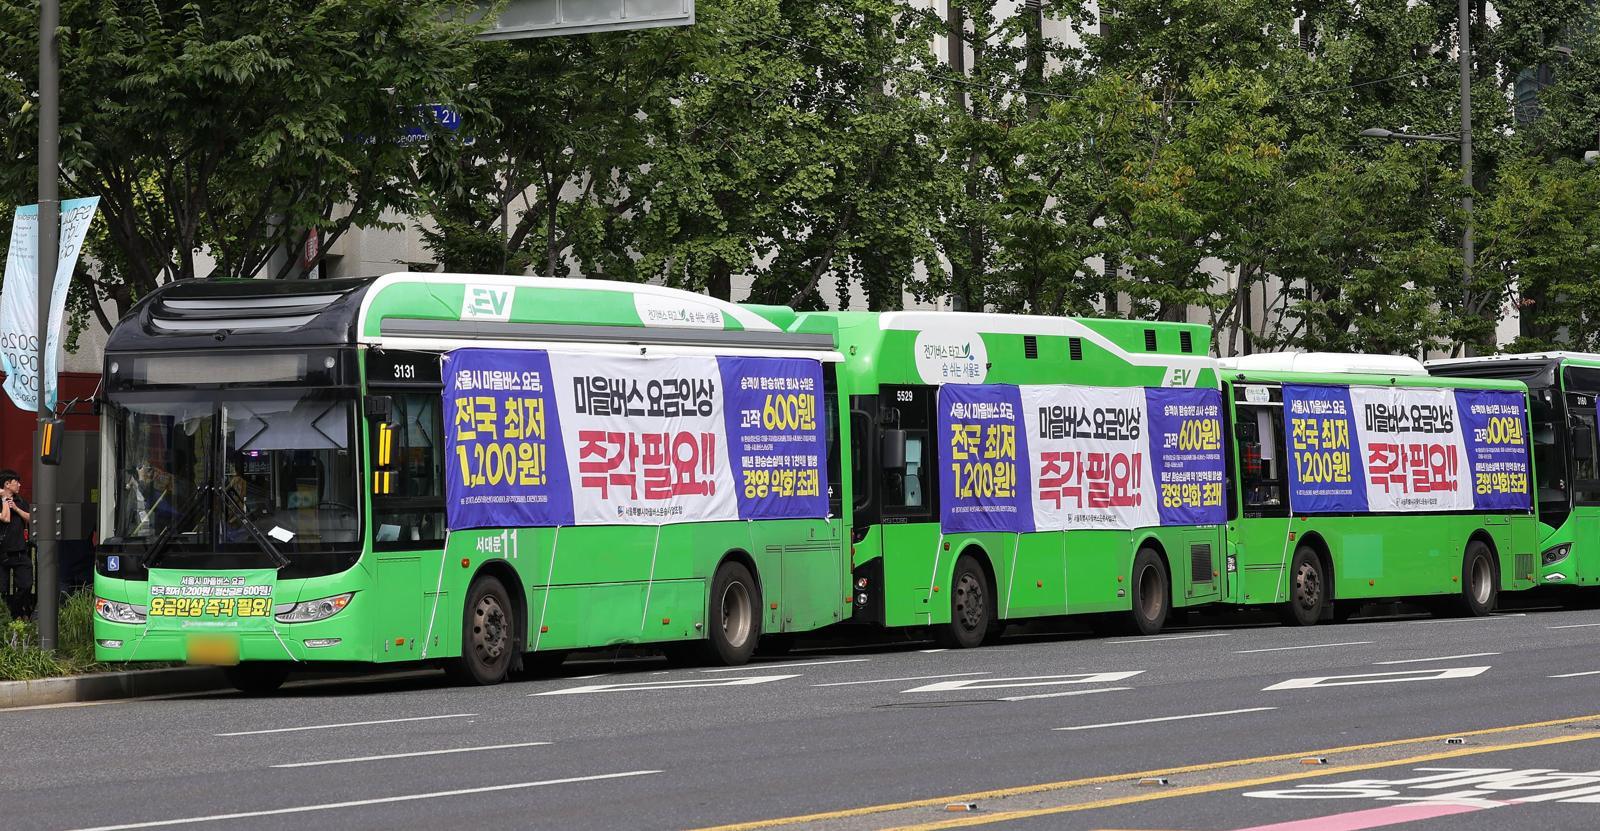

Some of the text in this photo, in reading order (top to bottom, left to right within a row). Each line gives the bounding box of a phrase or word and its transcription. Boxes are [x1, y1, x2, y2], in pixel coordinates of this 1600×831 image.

[472, 288, 508, 316] EV
[924, 344, 961, 359] 전기버스 타고
[394, 364, 415, 378] 3131
[455, 370, 543, 393] 서울시 마을버스 요금,
[741, 377, 759, 390] 승객이
[760, 377, 785, 390] 환승하면
[786, 378, 799, 391] 회사
[942, 362, 980, 378] 숨 쉬는 서울로
[1173, 369, 1191, 385] EV
[573, 376, 715, 418] 마을버스 요금인상
[897, 391, 912, 401] 5529
[1291, 400, 1346, 415] 서울시 마을버스 요금,
[455, 397, 545, 441] 전국 최저
[741, 394, 816, 430] 고작 600원!
[950, 402, 1015, 421] 서울시 마을버스 요금,
[1039, 406, 1141, 440] 마을버스 요금인상
[1164, 405, 1178, 416] 승객이
[1365, 404, 1453, 434] 마을버스 요금인상
[951, 424, 1015, 460] 전국 최저
[1163, 419, 1220, 451] 고작 600원!
[1292, 418, 1349, 450] 전국 최저
[456, 442, 547, 488] 1,200원!
[579, 430, 715, 500] 즉각 필요!!
[742, 456, 754, 468] 매년
[807, 455, 818, 467] 발생
[1294, 451, 1351, 484] 1,200원!
[1368, 443, 1458, 493] 즉각 필요!!
[743, 469, 819, 498] 경영 악화 초래
[951, 462, 1016, 500] 1,200원!
[1039, 452, 1142, 509] 즉각 필요!!
[1161, 483, 1222, 508] 경영 악화 초래
[151, 586, 165, 596] 전국
[165, 587, 180, 596] 최저
[244, 586, 272, 596] 600원!
[181, 576, 245, 586] 서울시 마을버스 요금
[149, 597, 272, 617] 요금인상 즉각 필요!
